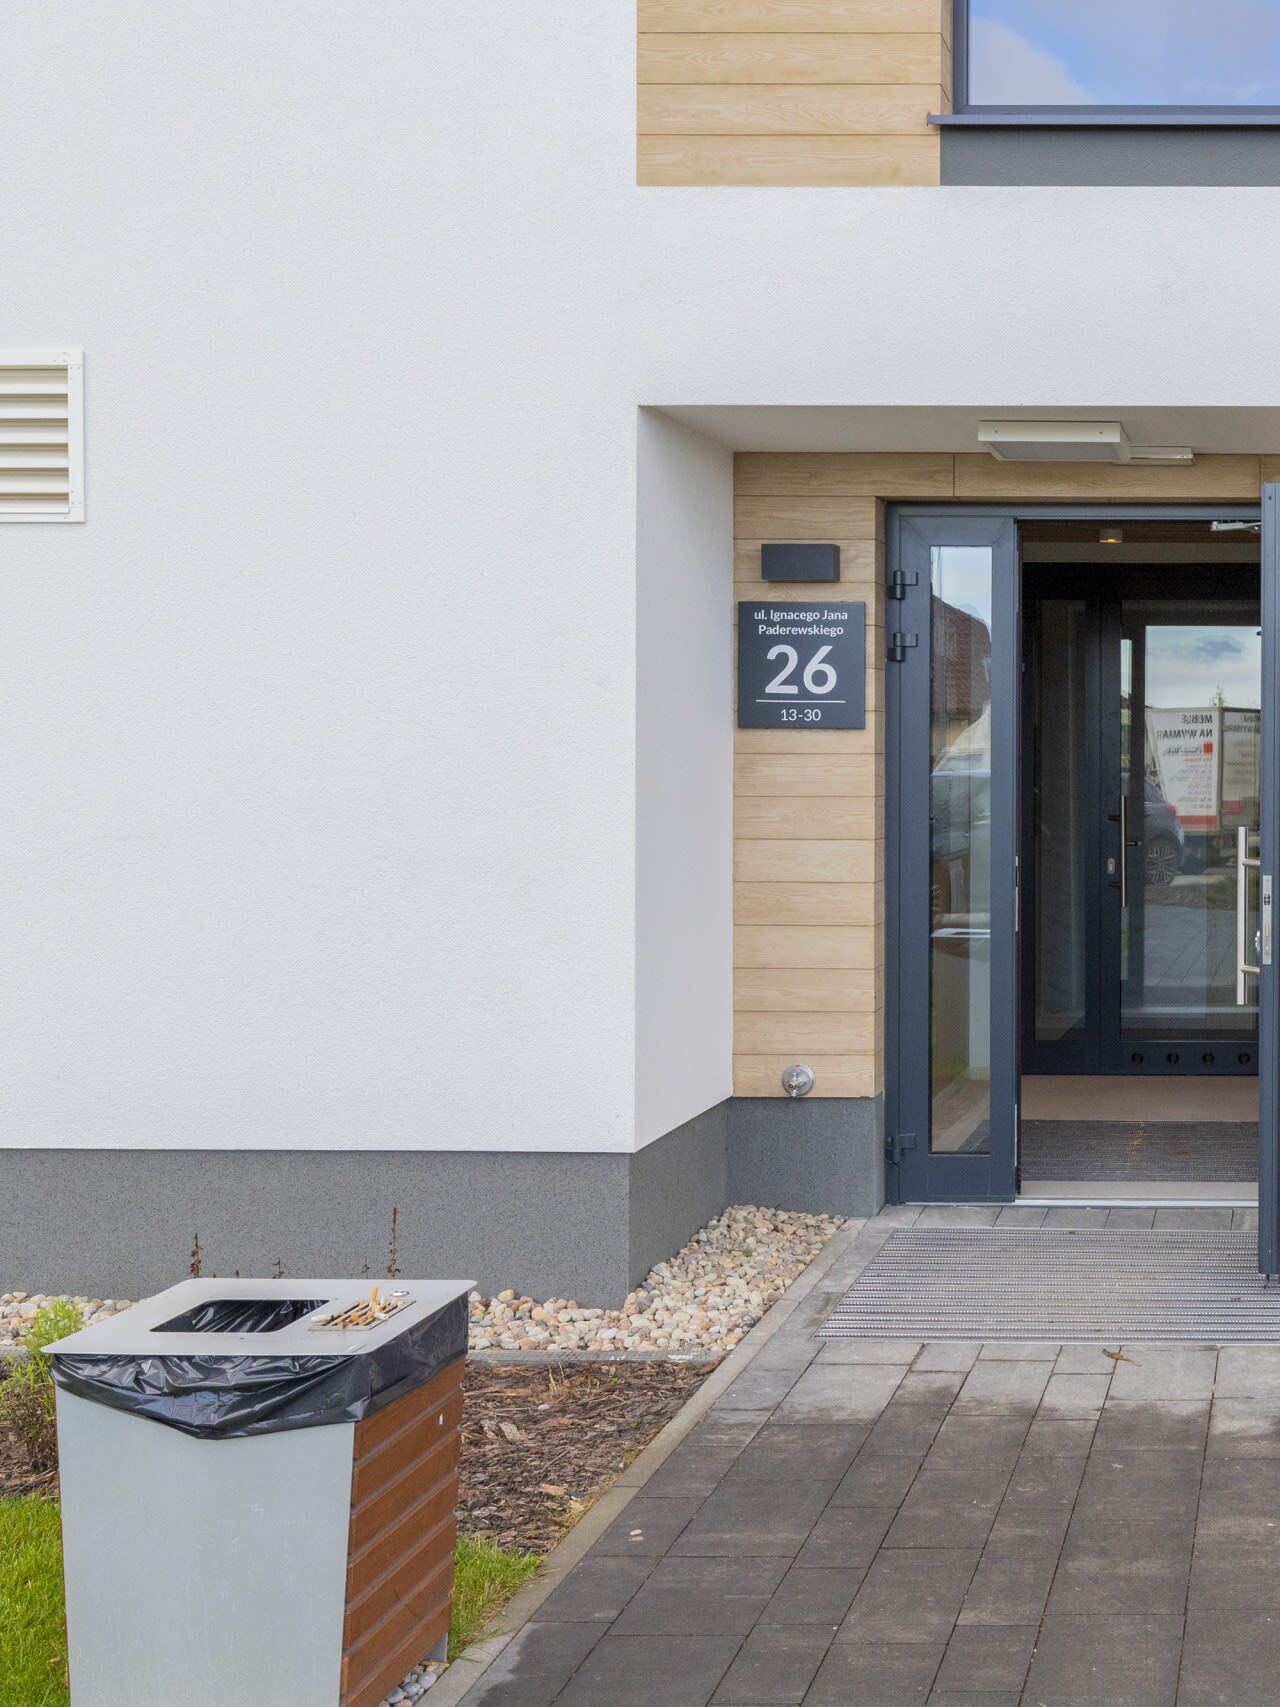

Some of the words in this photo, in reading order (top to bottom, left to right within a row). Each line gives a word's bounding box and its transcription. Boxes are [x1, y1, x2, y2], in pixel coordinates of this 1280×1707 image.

[754, 609, 768, 620] ul.
[770, 609, 820, 622] Ignacego
[821, 609, 848, 620] Jana
[758, 624, 844, 637] Paderewskiego
[765, 644, 837, 694] 26
[780, 708, 822, 721] 13-30
